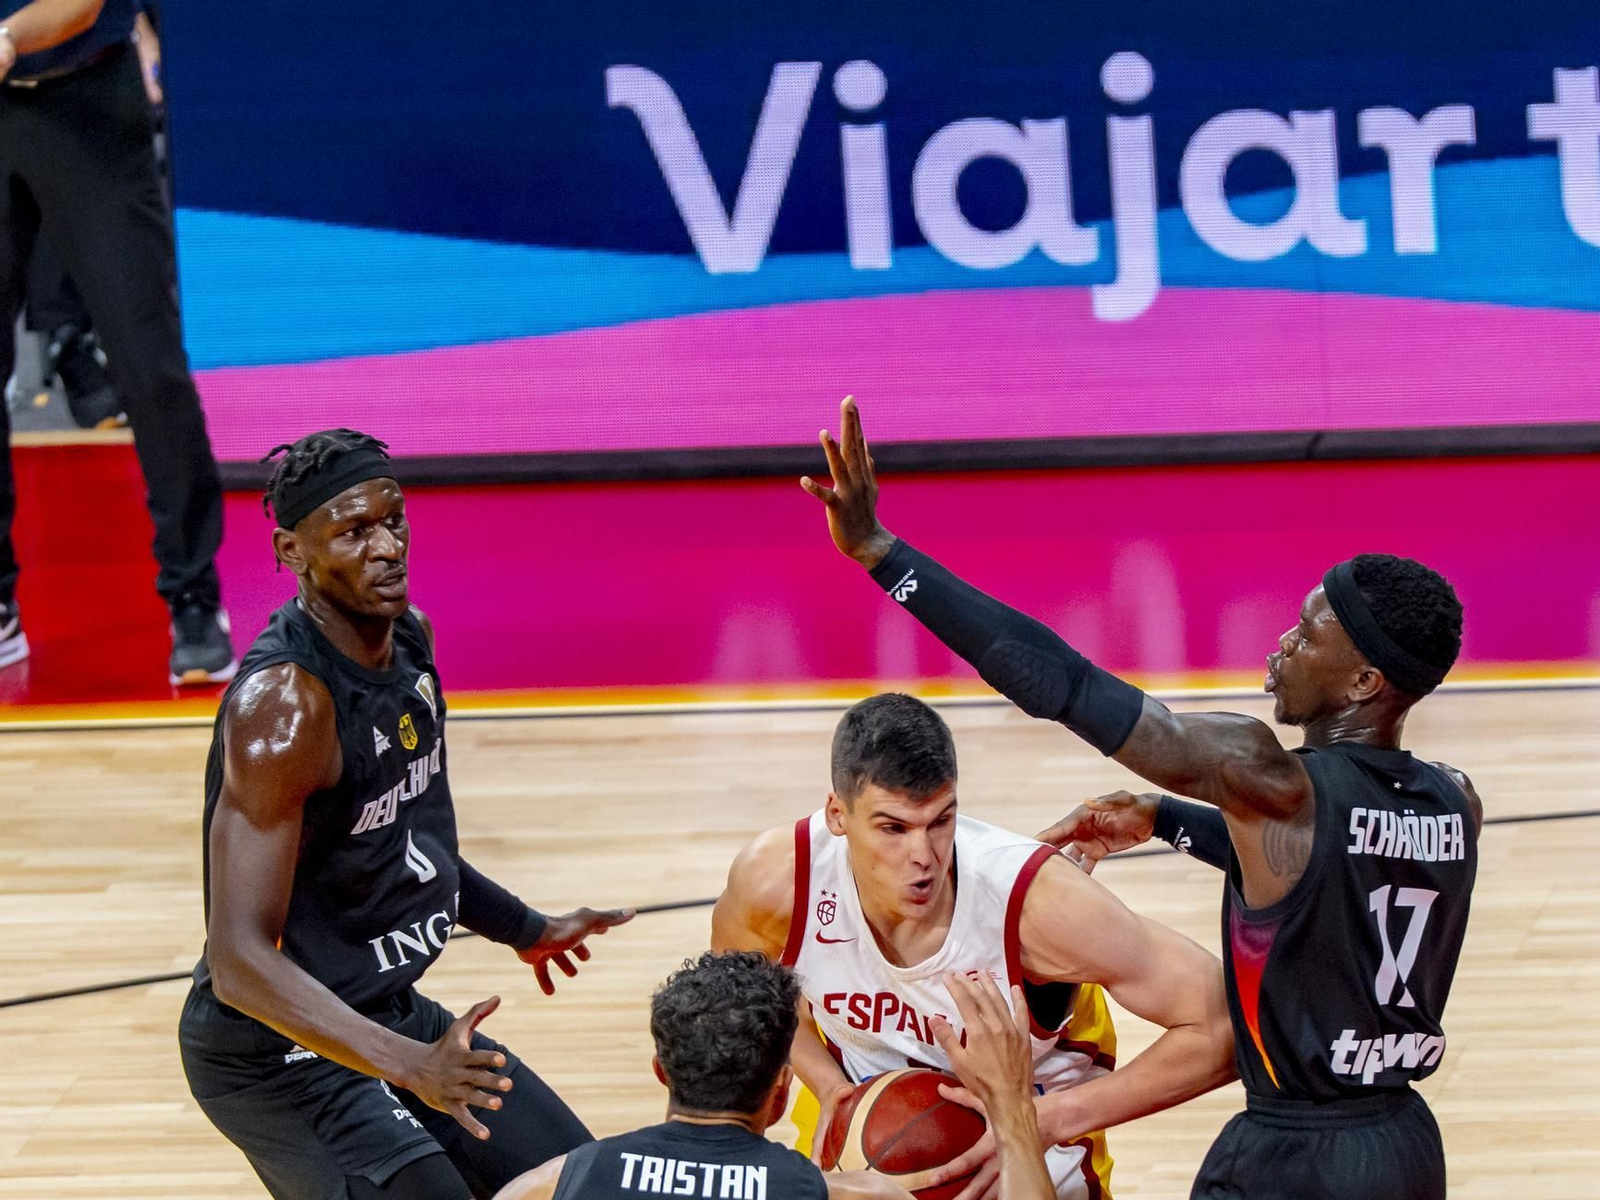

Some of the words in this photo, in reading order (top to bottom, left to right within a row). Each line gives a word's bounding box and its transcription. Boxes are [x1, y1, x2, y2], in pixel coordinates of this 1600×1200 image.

[605, 51, 1477, 321] Viajar
[368, 910, 453, 973] ING
[1369, 884, 1440, 1008] 17
[823, 991, 968, 1049] ESPA
